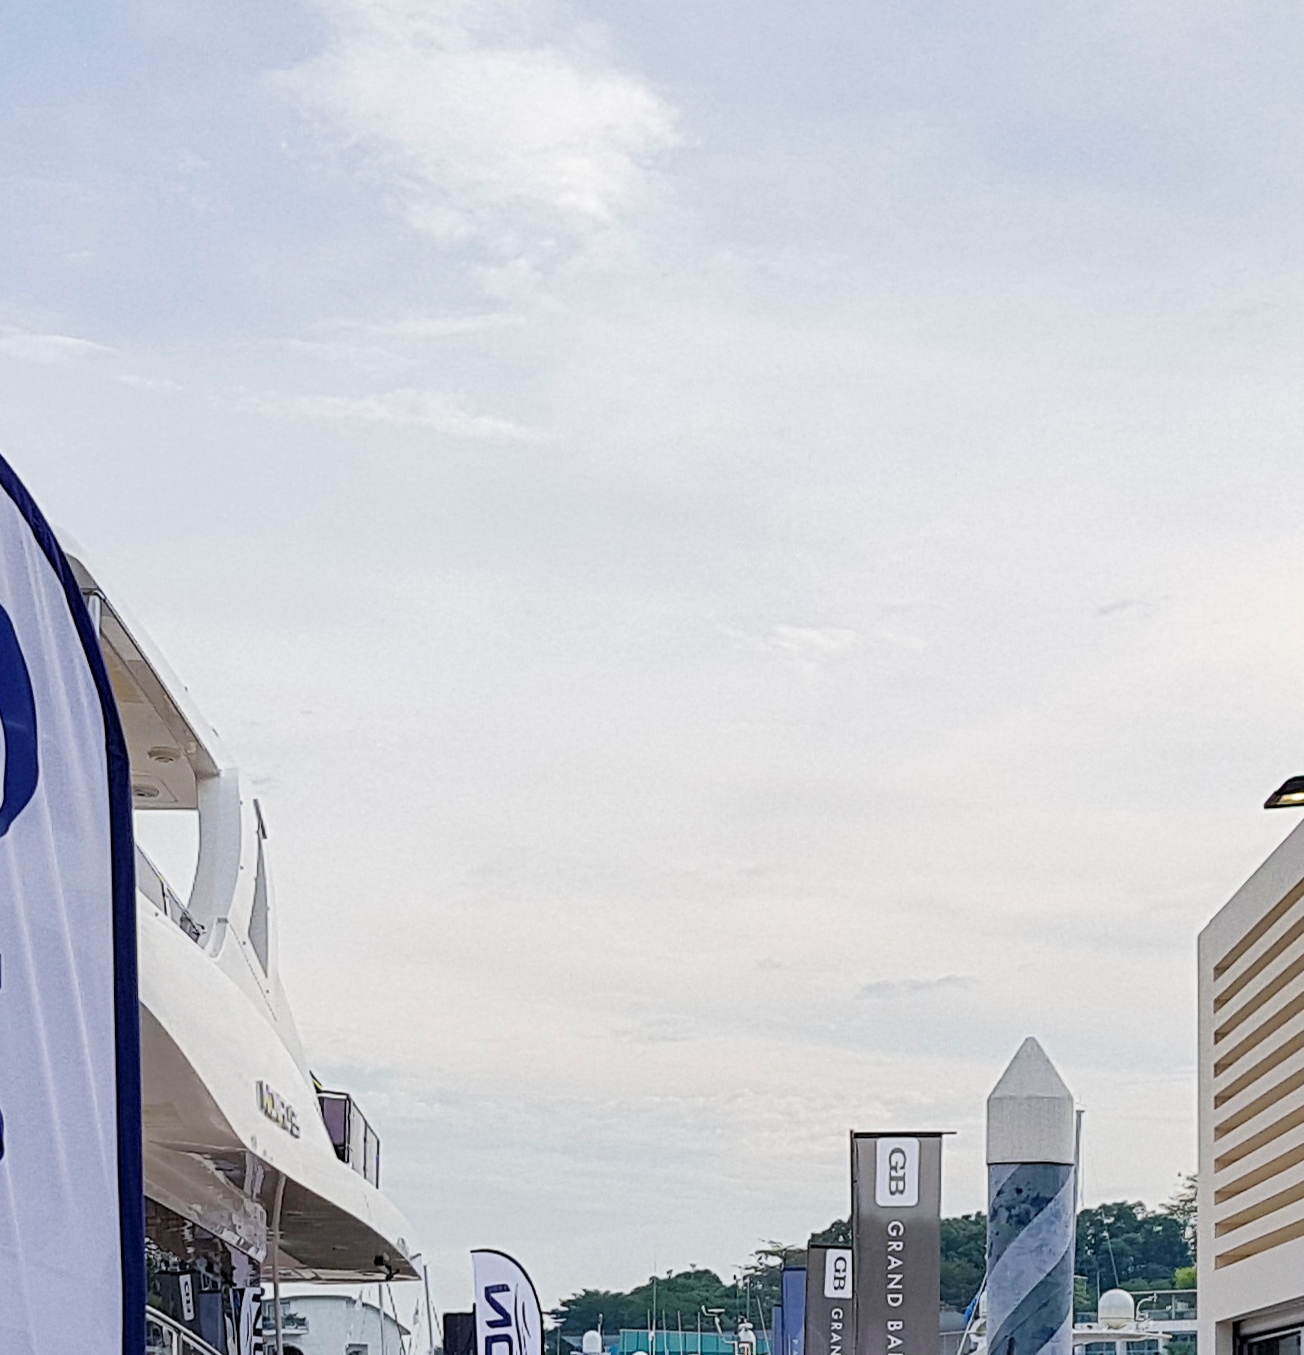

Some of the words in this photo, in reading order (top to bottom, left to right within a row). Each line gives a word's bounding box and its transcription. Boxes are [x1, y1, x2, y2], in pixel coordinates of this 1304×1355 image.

[888, 1147, 906, 1196] GB
[833, 1256, 847, 1291] GB
[886, 1220, 904, 1307] GRAND
